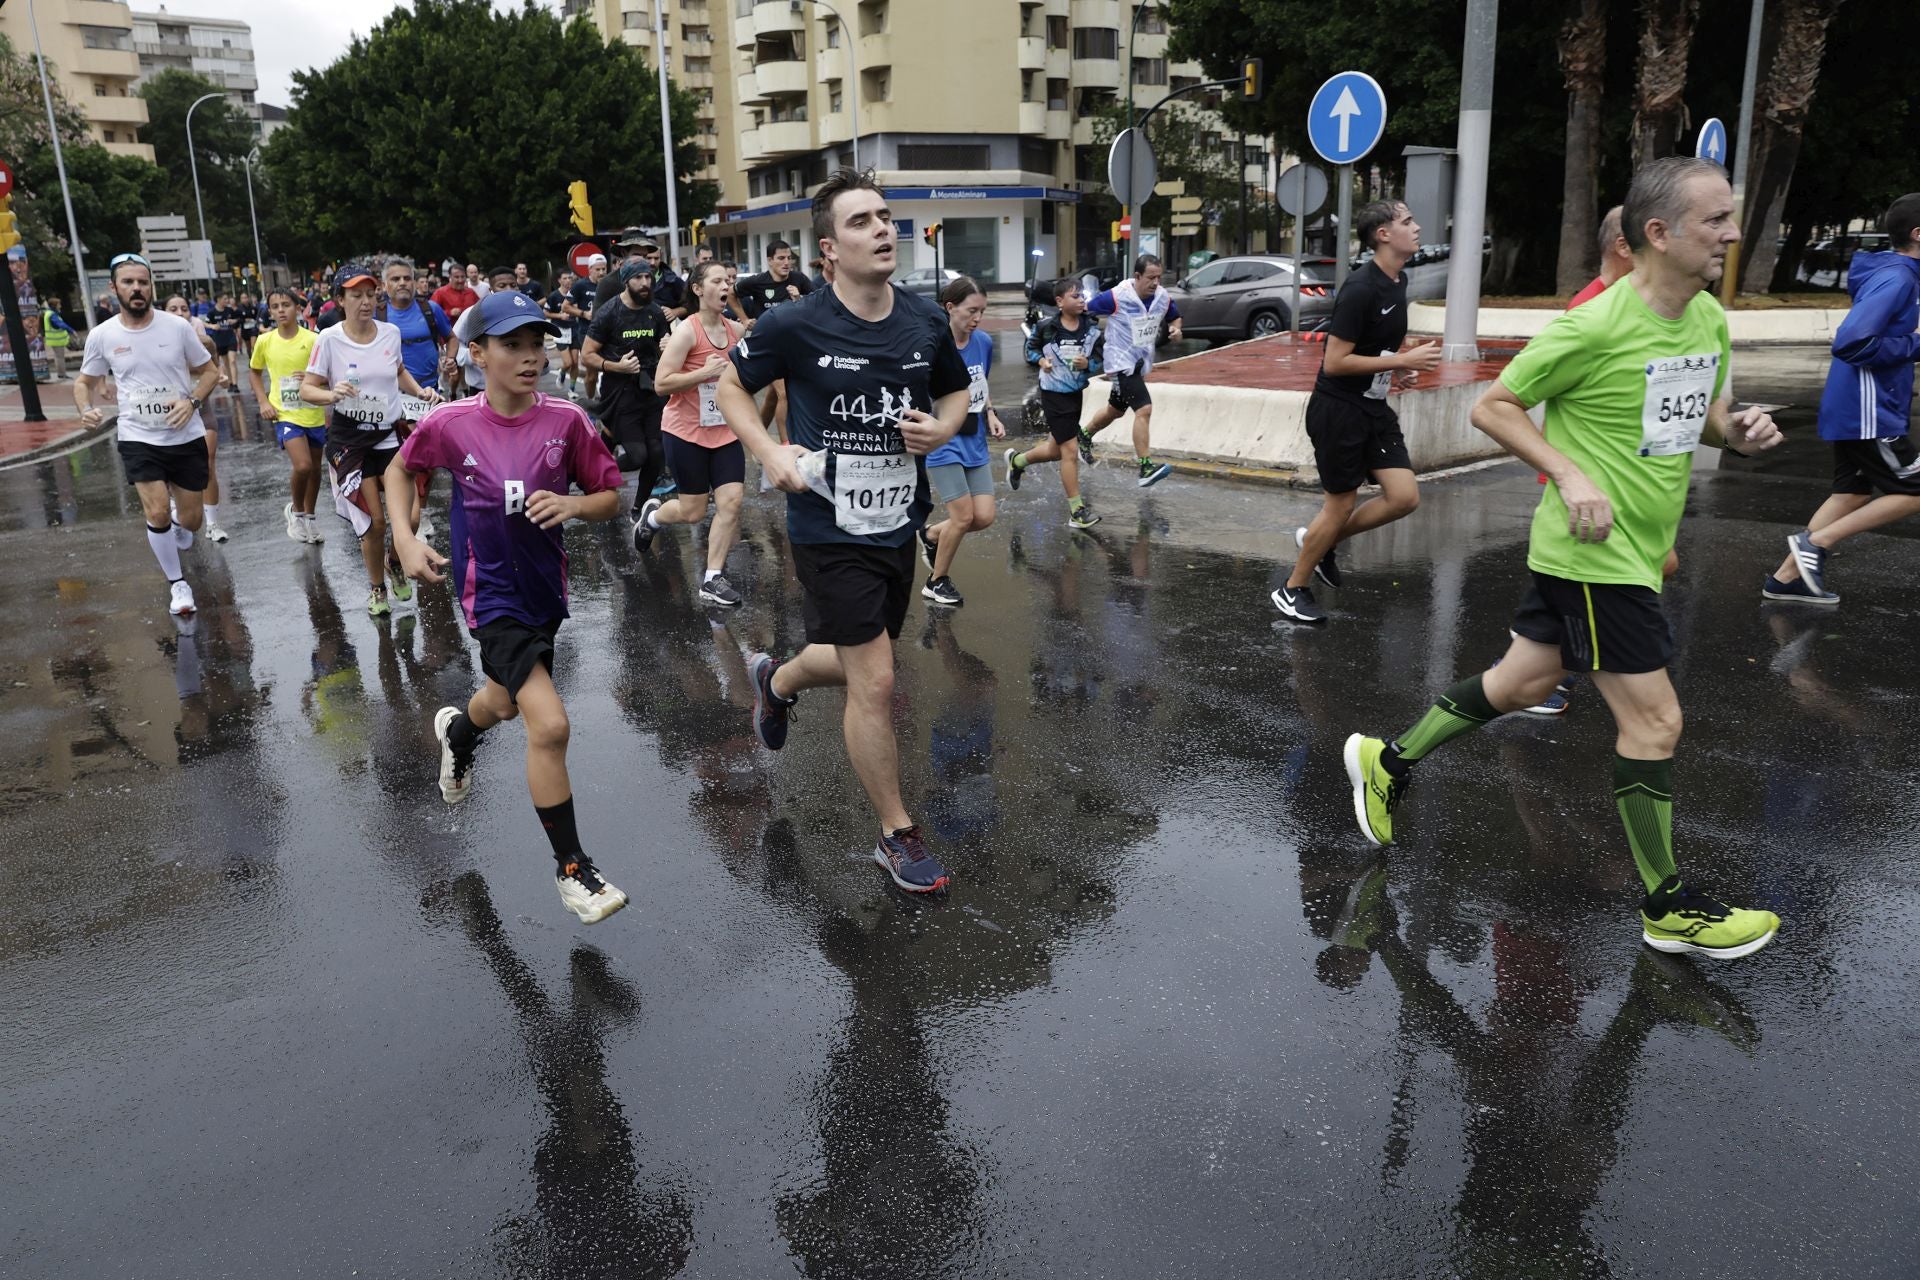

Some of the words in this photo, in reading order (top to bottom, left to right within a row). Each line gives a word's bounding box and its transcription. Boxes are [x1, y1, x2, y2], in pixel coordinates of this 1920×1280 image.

[622, 328, 654, 338] mayoral
[833, 356, 870, 365] Fundación
[833, 362, 861, 371] Unicaja
[283, 391, 300, 402] 20
[136, 403, 175, 415] 1109
[1659, 393, 1707, 423] 5423
[822, 430, 881, 442] CARRERA
[822, 439, 883, 452] URBANA
[845, 484, 912, 509] 10172
